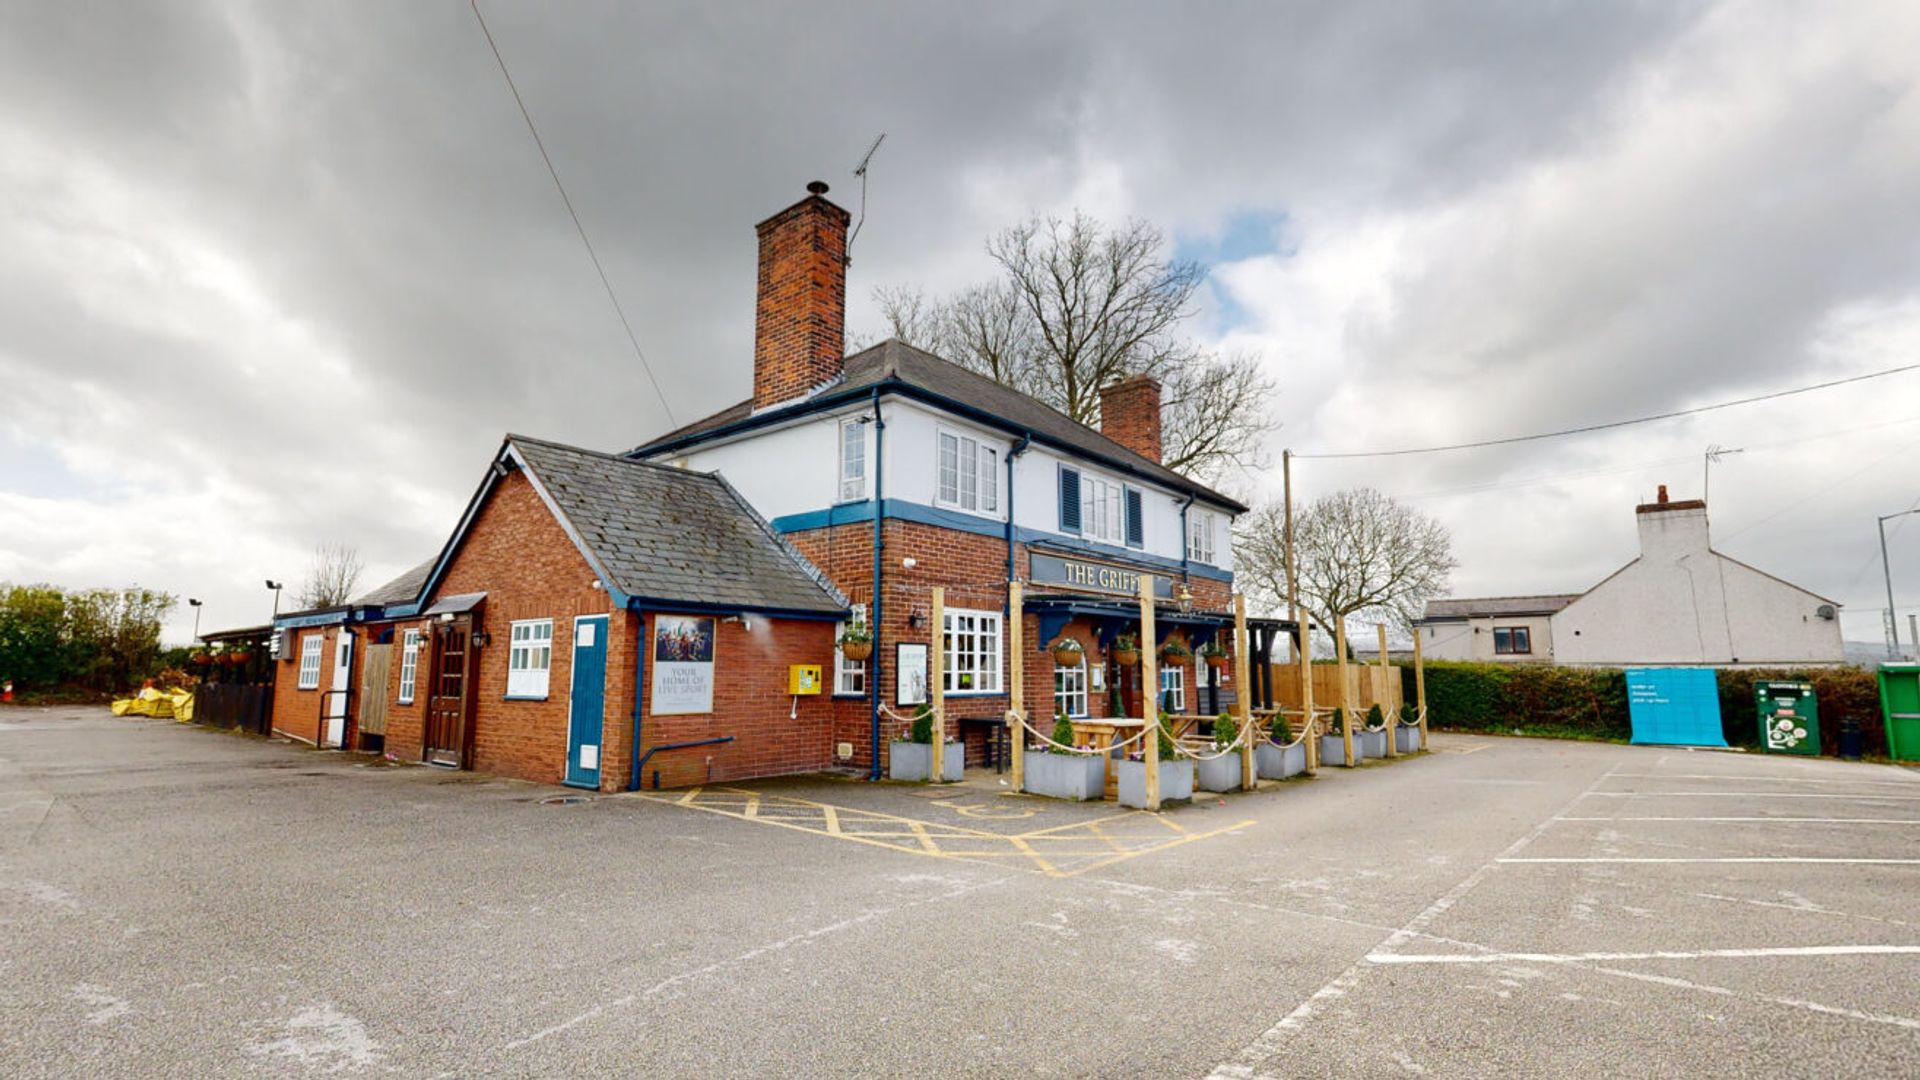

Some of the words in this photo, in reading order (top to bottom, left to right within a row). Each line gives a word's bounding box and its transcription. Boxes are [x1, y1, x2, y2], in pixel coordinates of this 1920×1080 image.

[1064, 562, 1095, 586] THE
[671, 667, 696, 676] YOUR
[662, 677, 689, 685] HOME
[692, 677, 704, 685] OF
[658, 685, 677, 694] LIVE
[680, 684, 707, 694] SPORT
